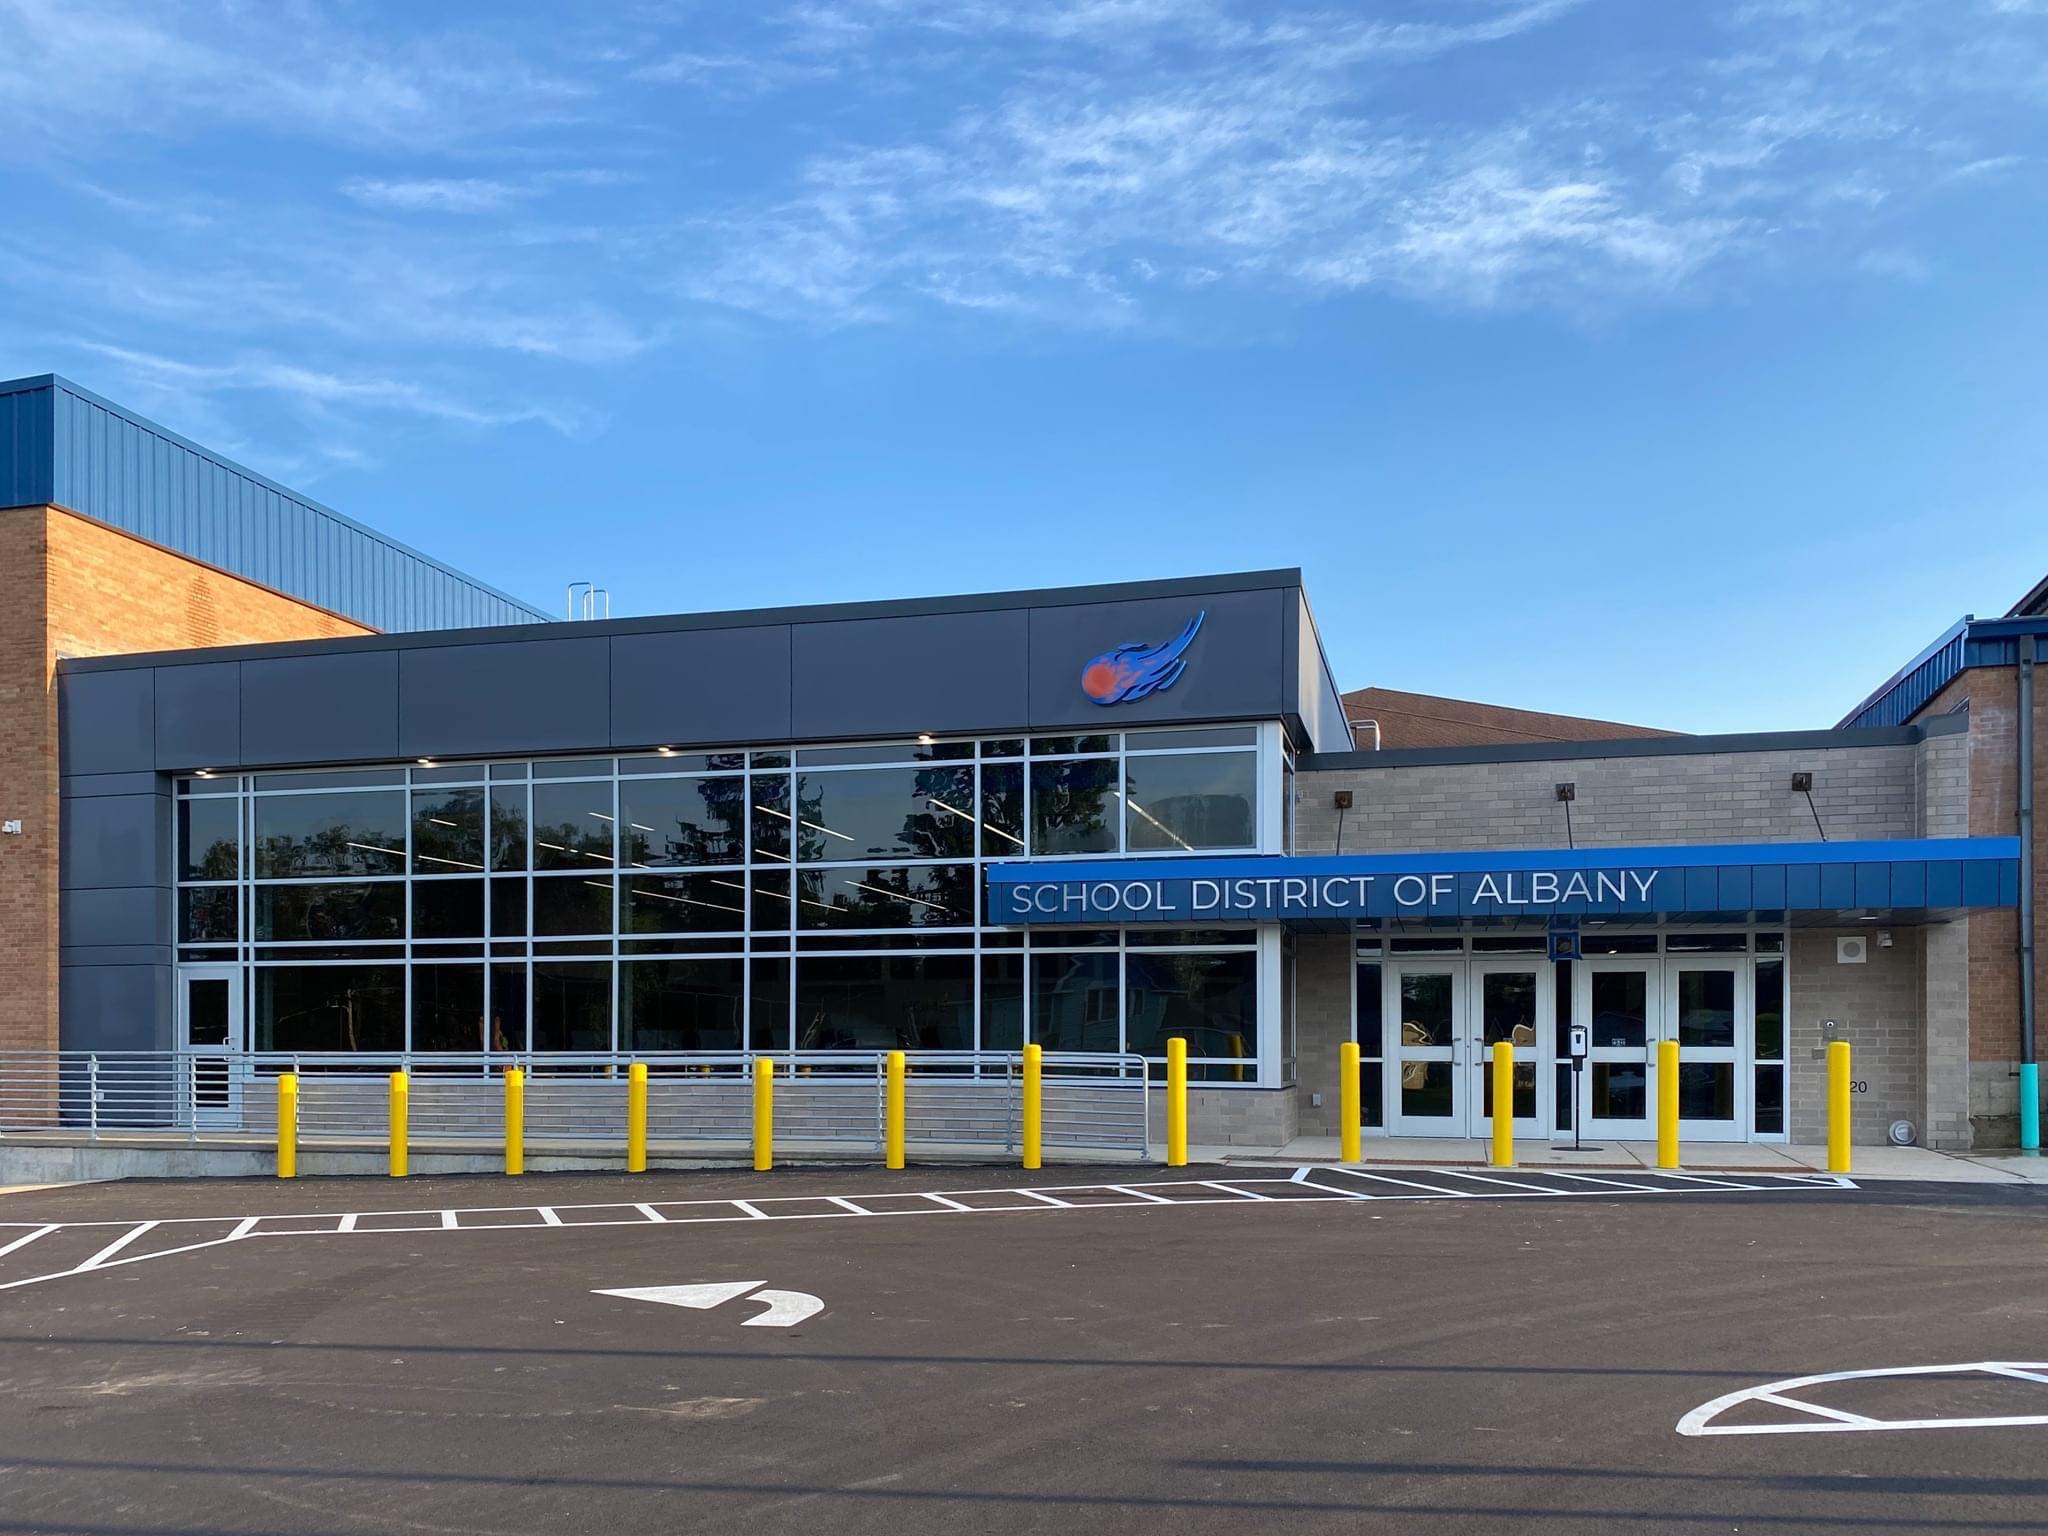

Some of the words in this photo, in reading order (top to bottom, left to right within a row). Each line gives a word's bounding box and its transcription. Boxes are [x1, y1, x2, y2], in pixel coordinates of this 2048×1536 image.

[1012, 882, 1176, 912] SCHOOL
[1192, 877, 1375, 910] DISTRICT
[1393, 875, 1454, 905] OF
[1472, 870, 1659, 904] ALBANY
